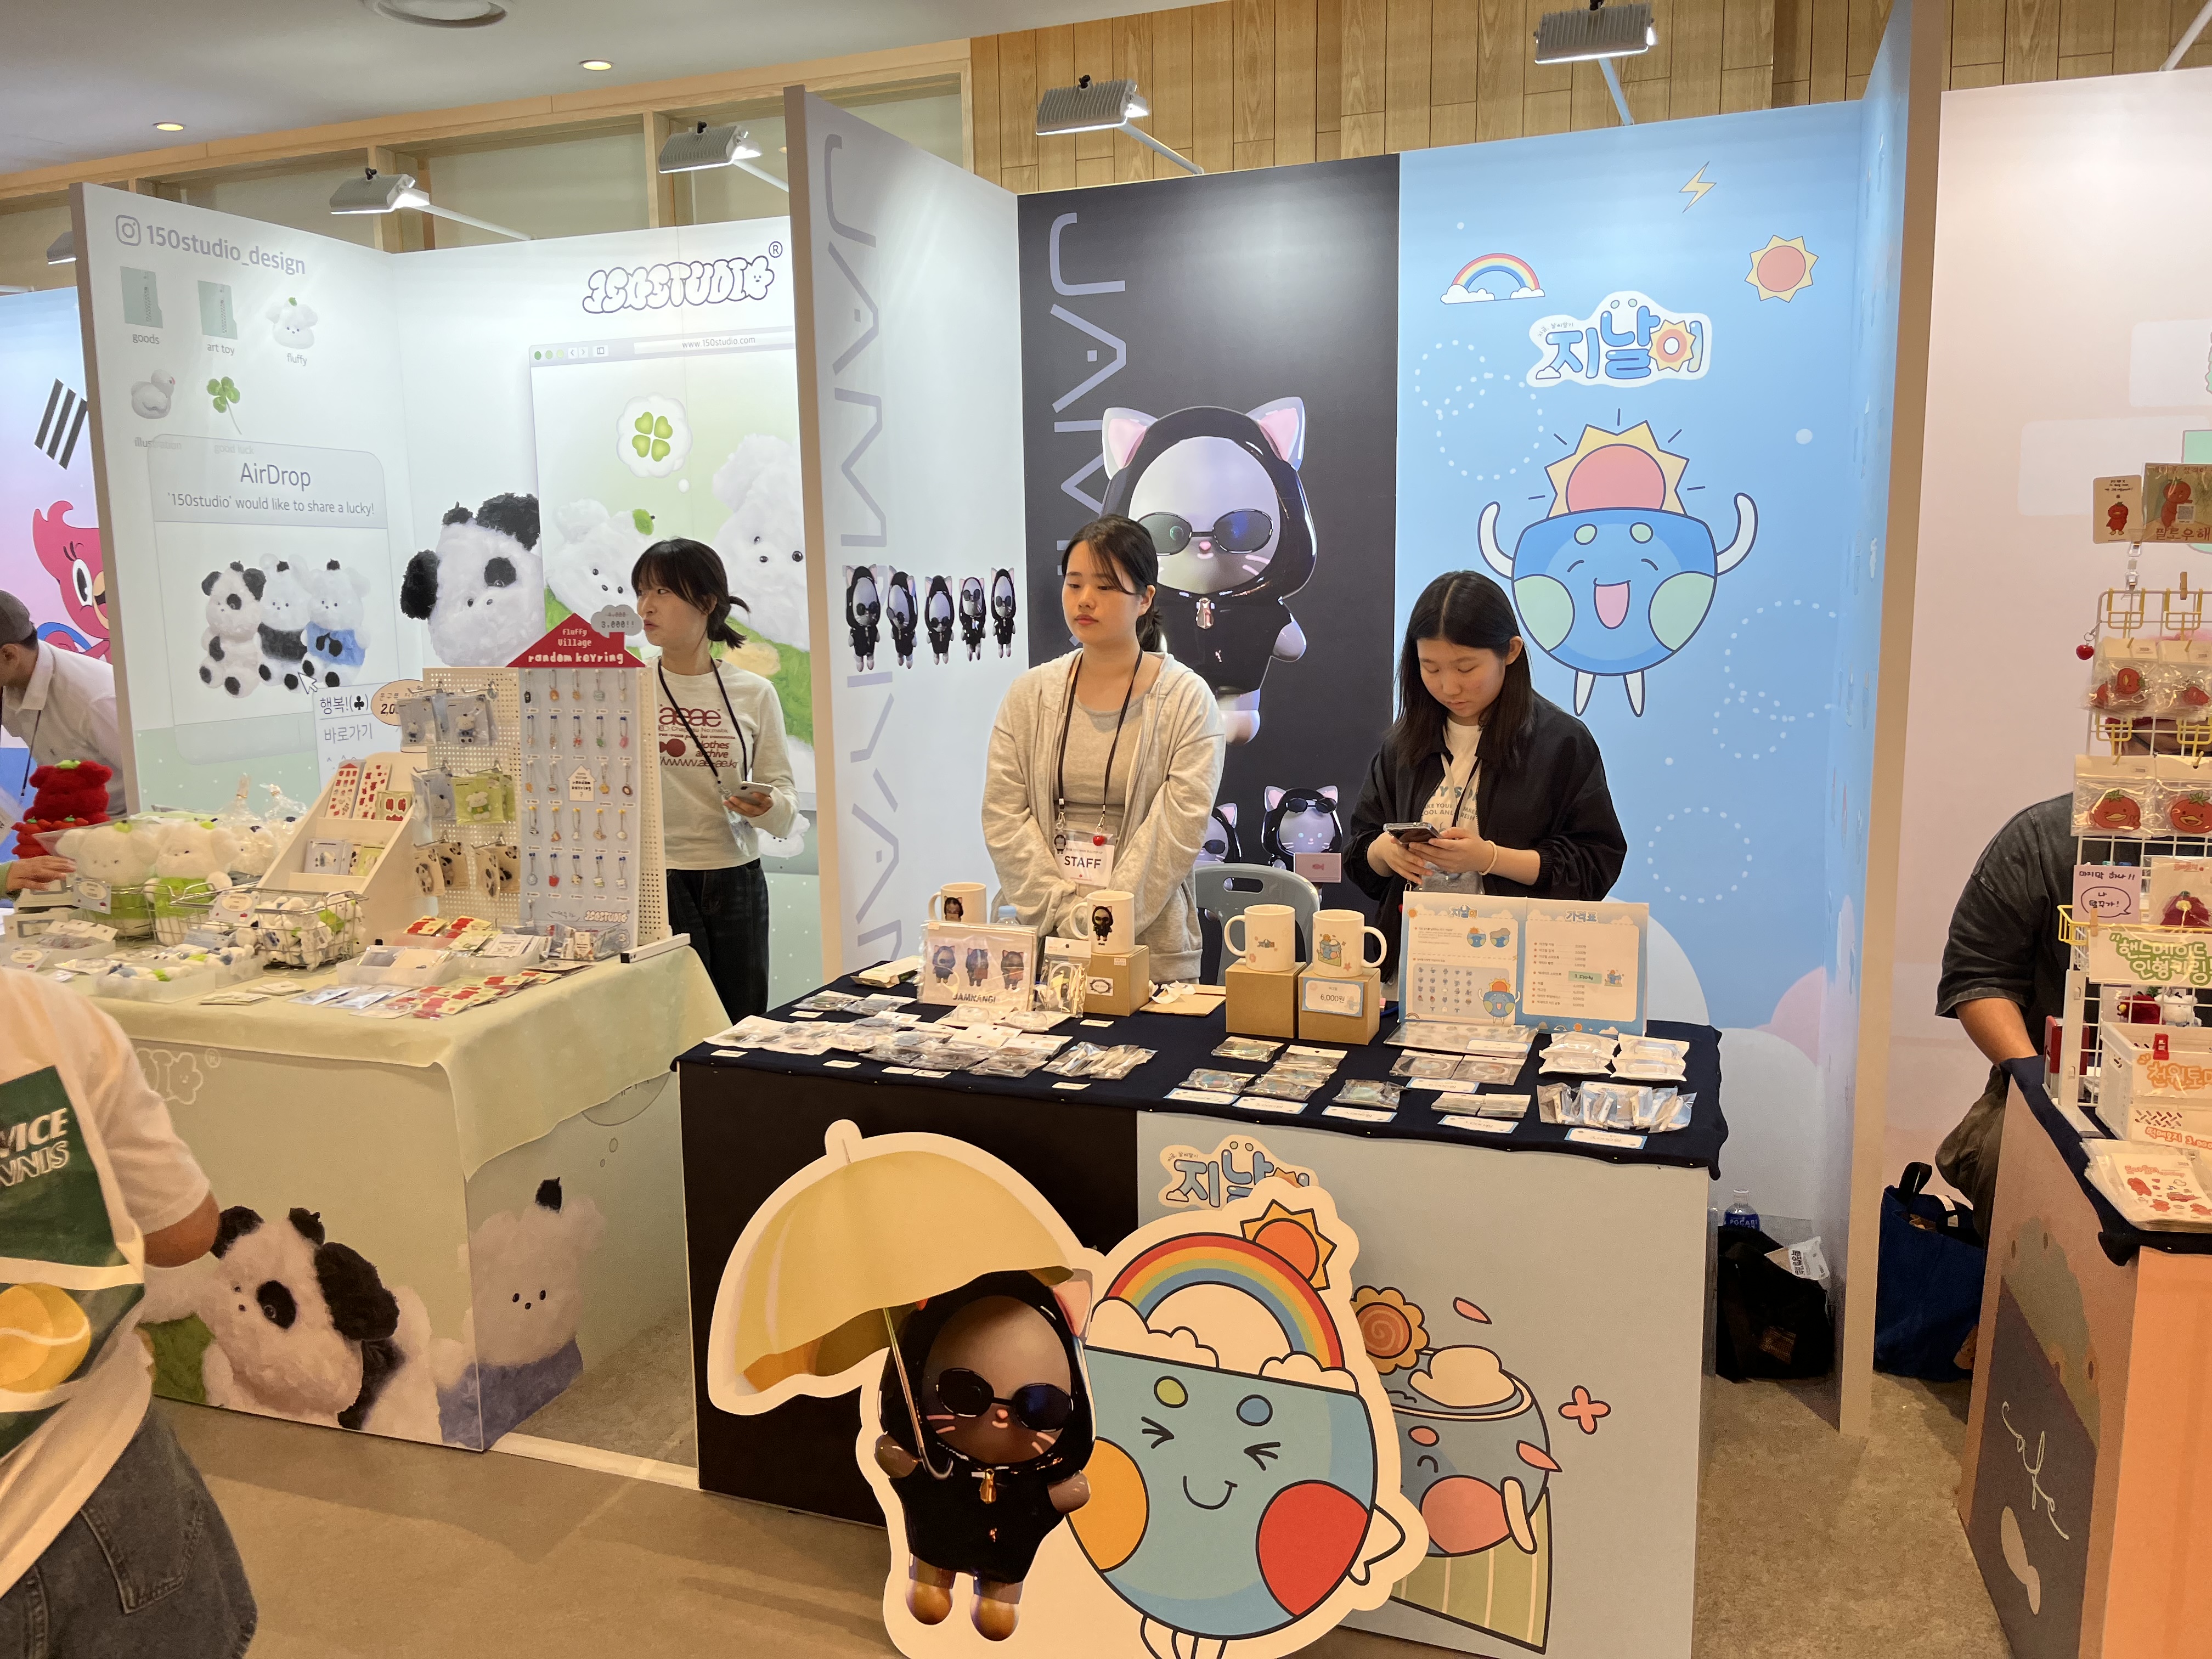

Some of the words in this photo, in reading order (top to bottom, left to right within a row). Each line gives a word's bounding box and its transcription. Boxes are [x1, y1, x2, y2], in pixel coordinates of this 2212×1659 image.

[146, 225, 306, 275] 150studio_design
[132, 333, 160, 345] goods
[681, 336, 756, 348] www.150studio.com
[207, 343, 219, 352] art
[221, 345, 235, 356] toy
[287, 353, 308, 366] fluffy
[134, 437, 182, 450] illustration
[214, 444, 235, 454] good
[237, 445, 255, 454] luck
[240, 462, 311, 492] AirDrop
[168, 493, 232, 509] '150studio'
[235, 497, 269, 510] would
[272, 498, 290, 511] like
[294, 501, 304, 512] to
[307, 499, 335, 514] share
[338, 504, 343, 514] a
[346, 502, 375, 517] lucky!
[562, 628, 588, 637] fluffy
[557, 639, 592, 648] Village
[528, 651, 573, 663] random
[324, 723, 373, 744] 바로가기
[1064, 855, 1102, 868] STAFF
[2079, 871, 2104, 879] 마지막
[1565, 910, 1598, 923] 가격표
